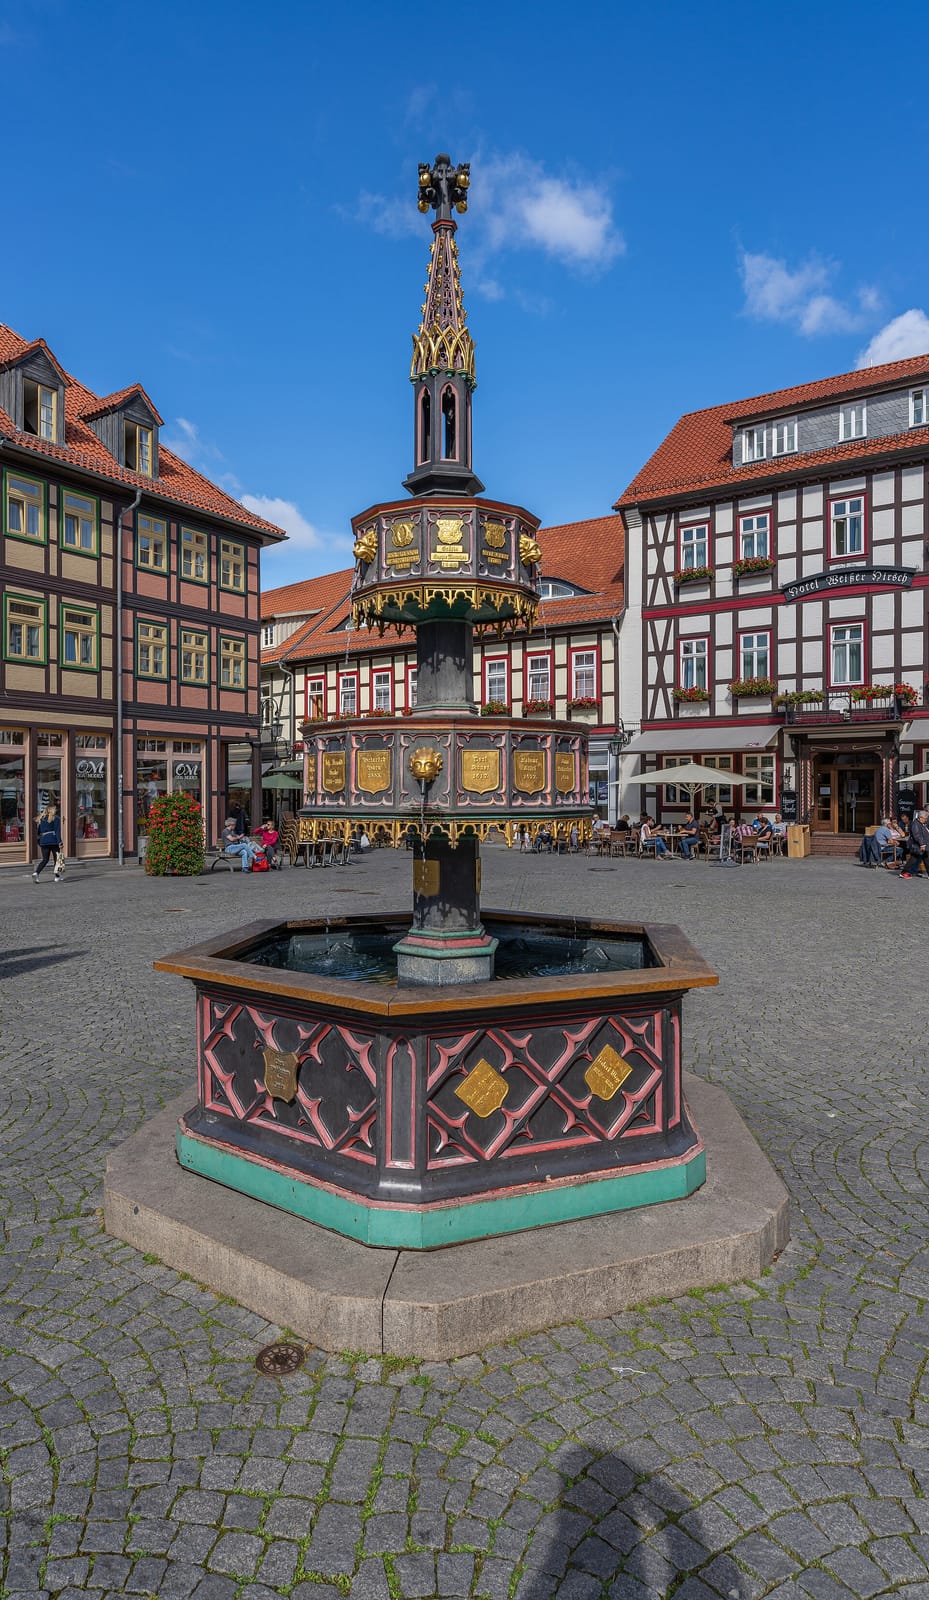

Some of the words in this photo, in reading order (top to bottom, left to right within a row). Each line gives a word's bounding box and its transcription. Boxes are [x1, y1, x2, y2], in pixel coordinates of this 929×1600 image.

[788, 579, 818, 597] Hotel
[826, 573, 866, 585] Weißer
[872, 570, 908, 585] Hirsch
